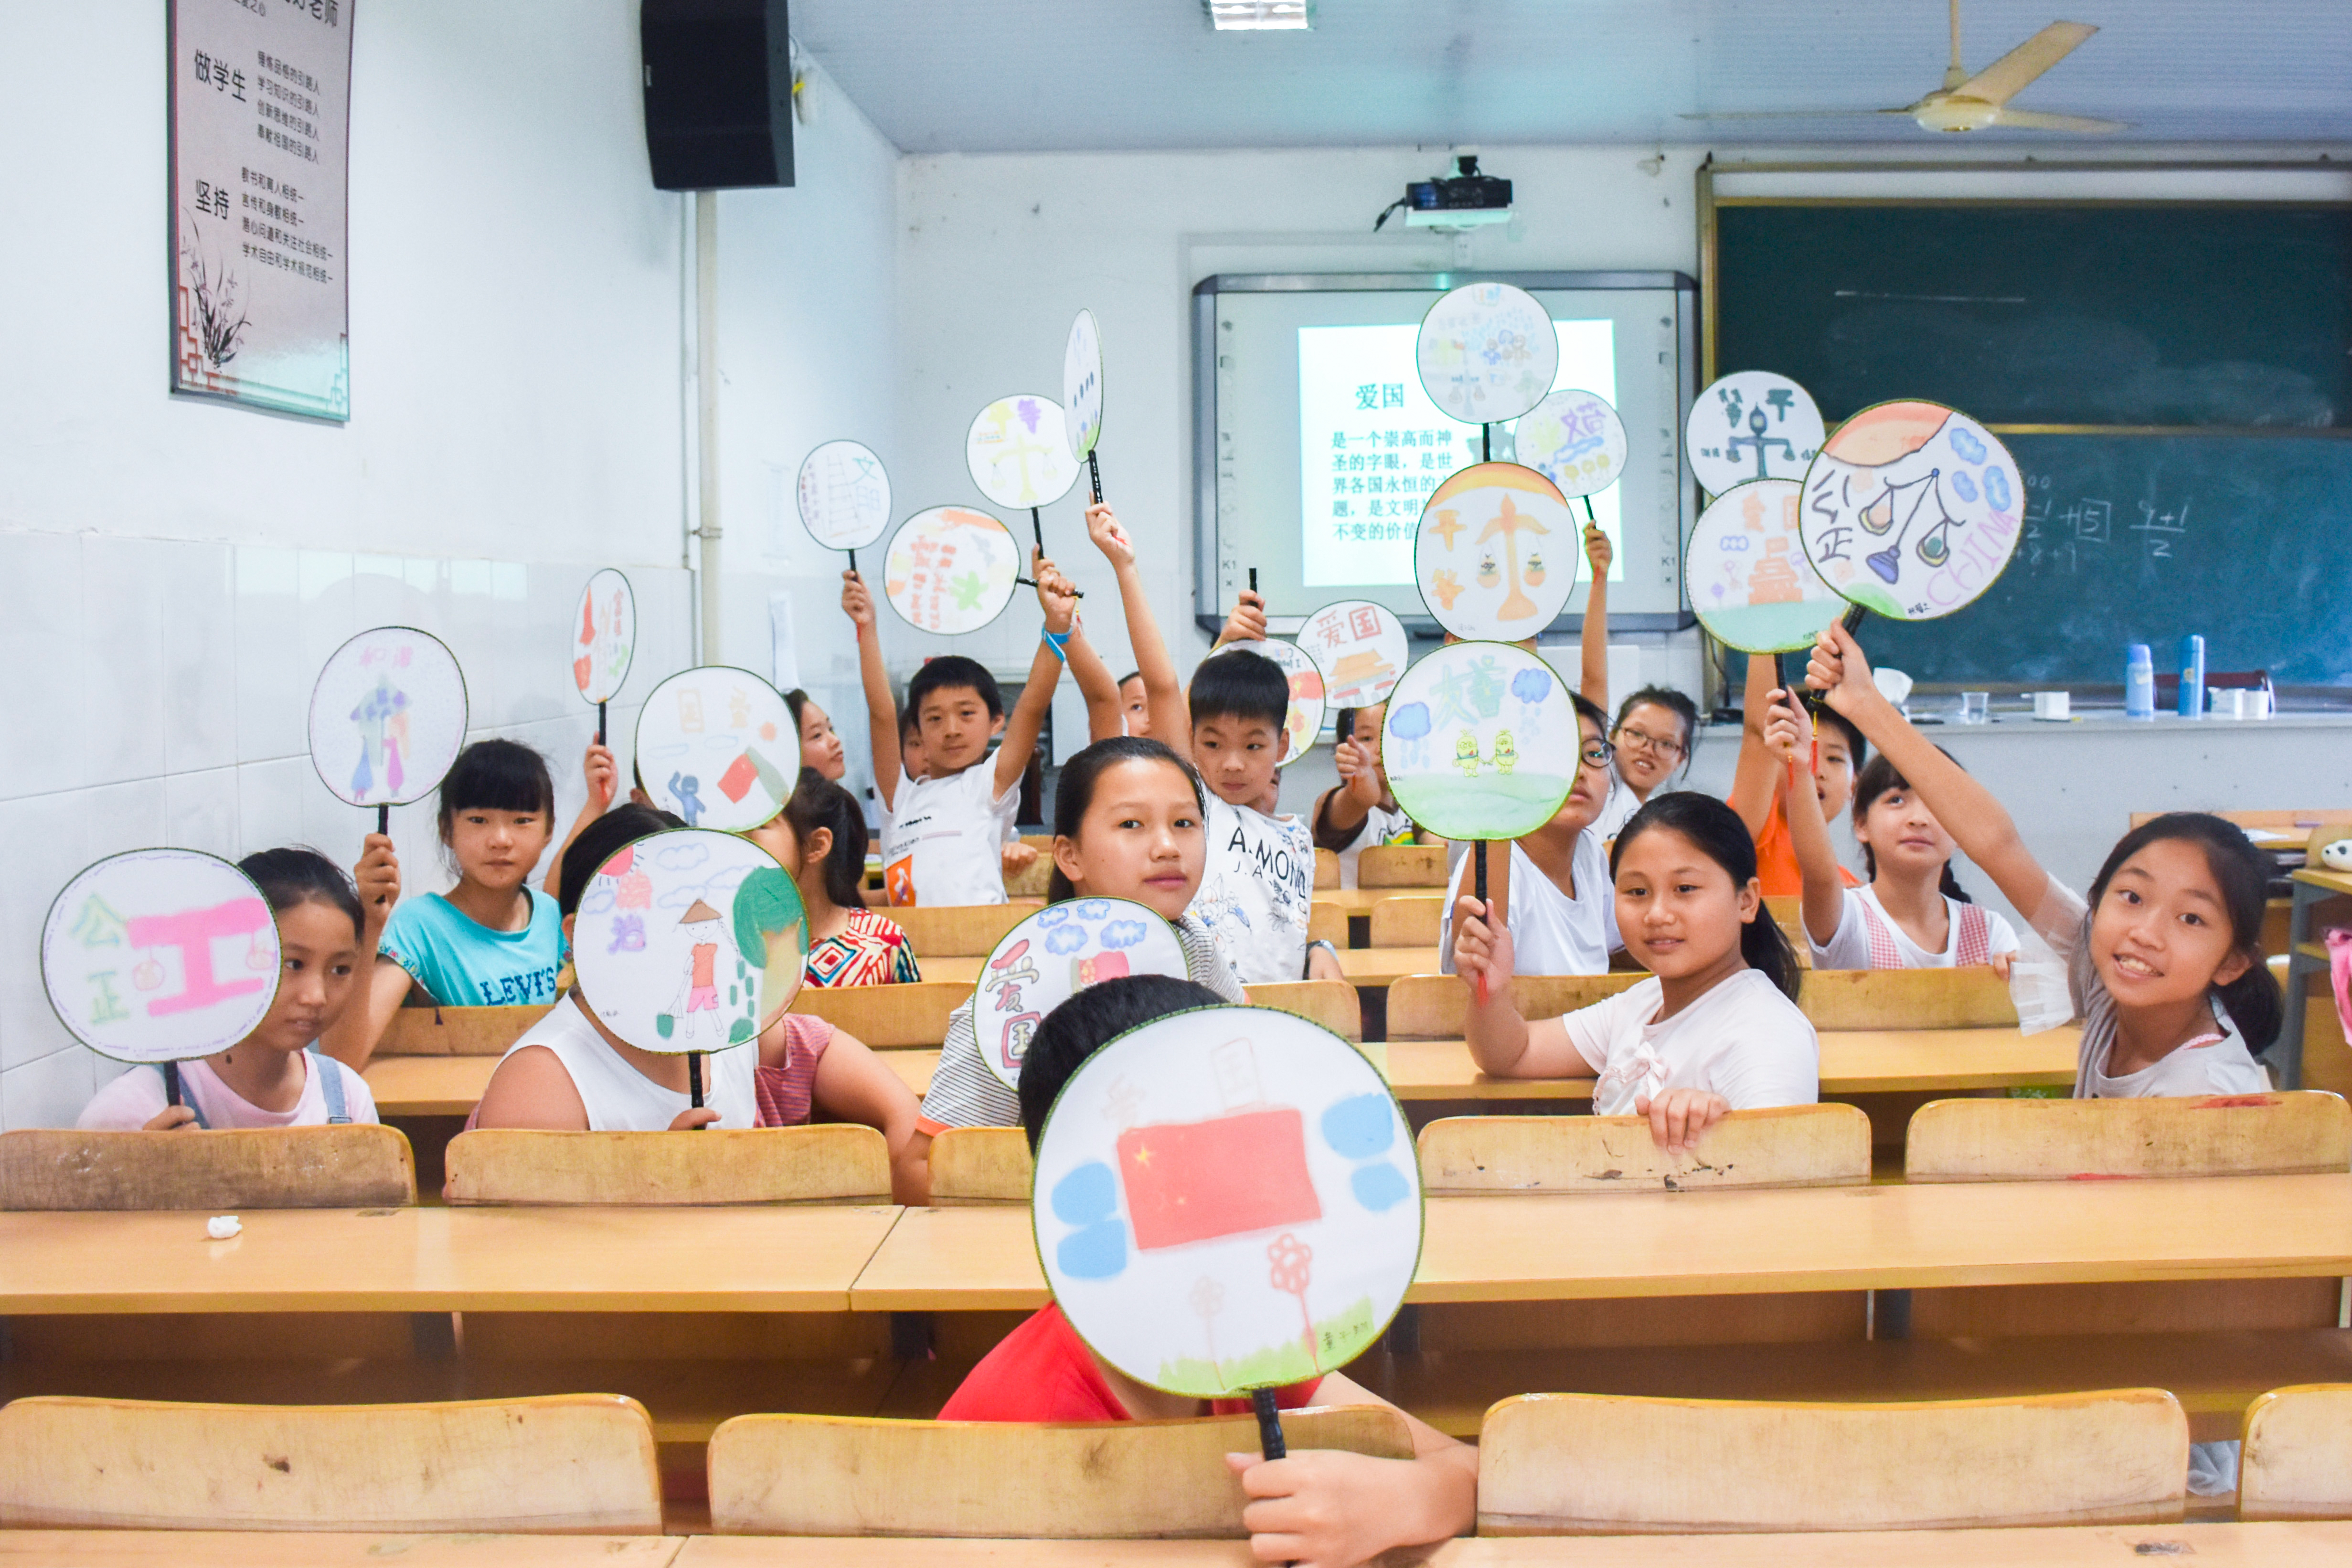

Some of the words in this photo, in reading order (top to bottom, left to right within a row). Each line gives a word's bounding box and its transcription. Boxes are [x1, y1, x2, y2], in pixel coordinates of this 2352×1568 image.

[194, 49, 246, 102] 做学生
[195, 179, 229, 220] 坚持
[1355, 383, 1404, 410] 爱国
[1331, 429, 1452, 449] 是一个崇高而神
[1811, 469, 1853, 563] 公正
[1926, 509, 2019, 606] CHINA
[2149, 539, 2173, 559] 2
[1317, 605, 1383, 648] 爱国
[69, 892, 130, 1025] 公正
[479, 966, 555, 1006] LEVI'S
[985, 939, 1043, 1068] 爱国
